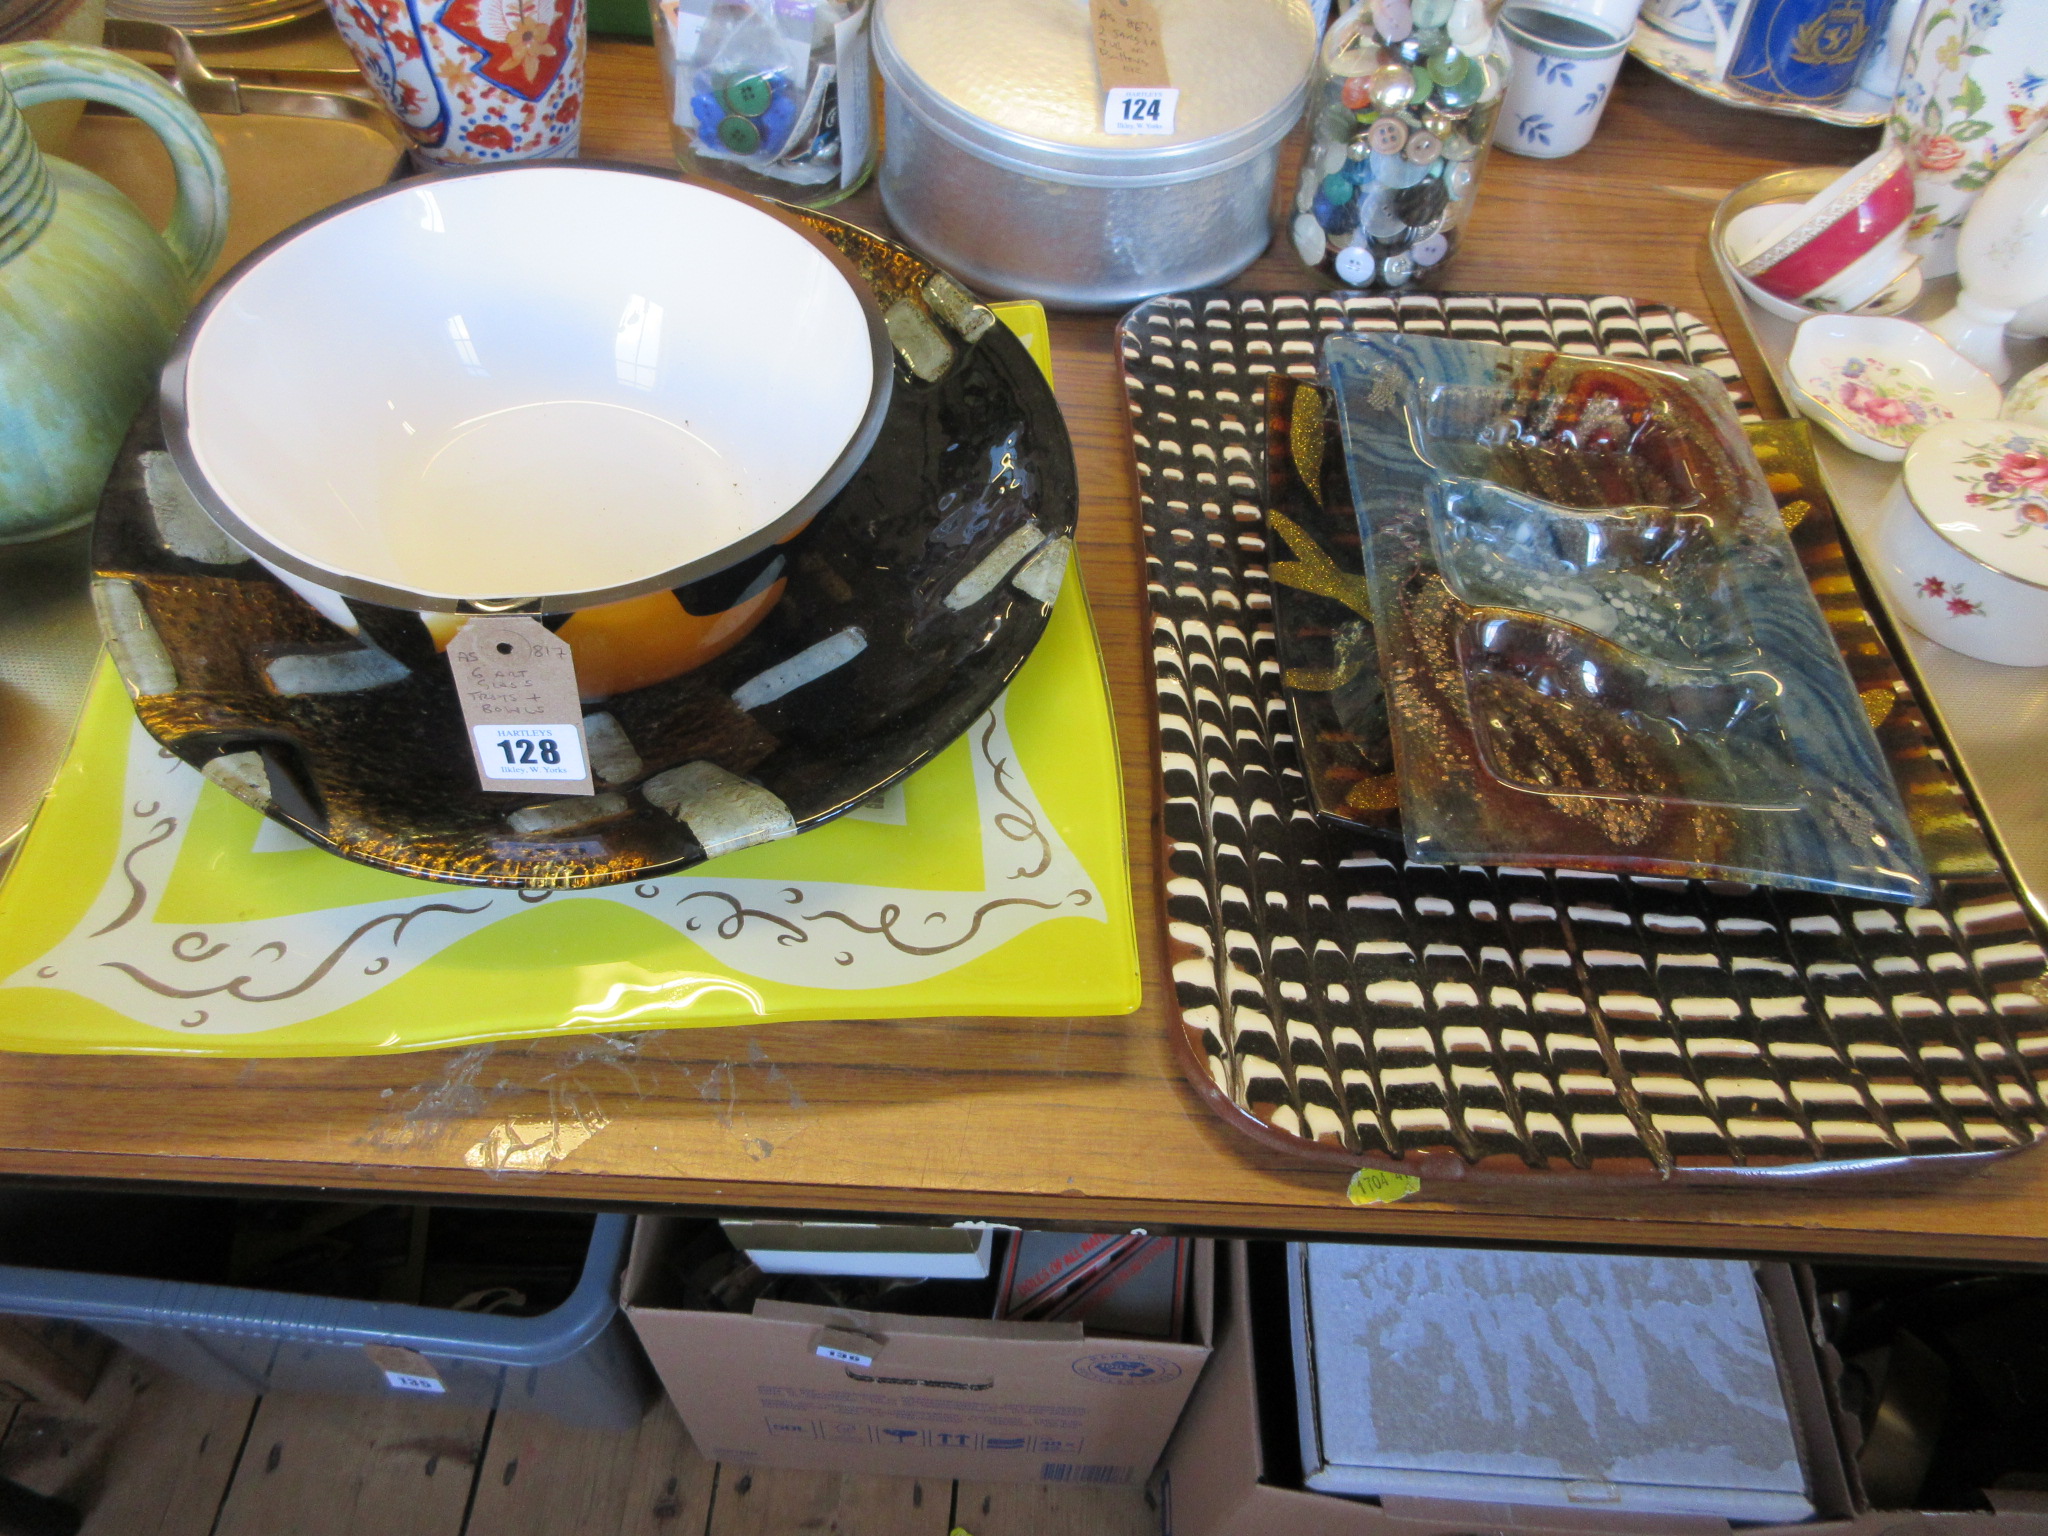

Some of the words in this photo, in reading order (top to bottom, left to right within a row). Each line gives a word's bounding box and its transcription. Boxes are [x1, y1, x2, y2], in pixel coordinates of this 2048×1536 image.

[1121, 98, 1161, 121] 124
[458, 651, 479, 662] AS
[532, 645, 567, 659] 817
[495, 670, 528, 678] ART
[477, 679, 533, 690] GLASS
[467, 692, 517, 702] TRAYS
[526, 693, 541, 701] +
[482, 703, 544, 714] BOWLS
[497, 729, 553, 737] HARTLEYS
[496, 738, 561, 765] 128
[501, 766, 528, 774] Ilkley,
[1357, 1172, 1389, 1195] 1704
[1049, 1258, 1064, 1275] OF
[1063, 1248, 1084, 1266] ALL
[400, 1377, 432, 1388] 135
